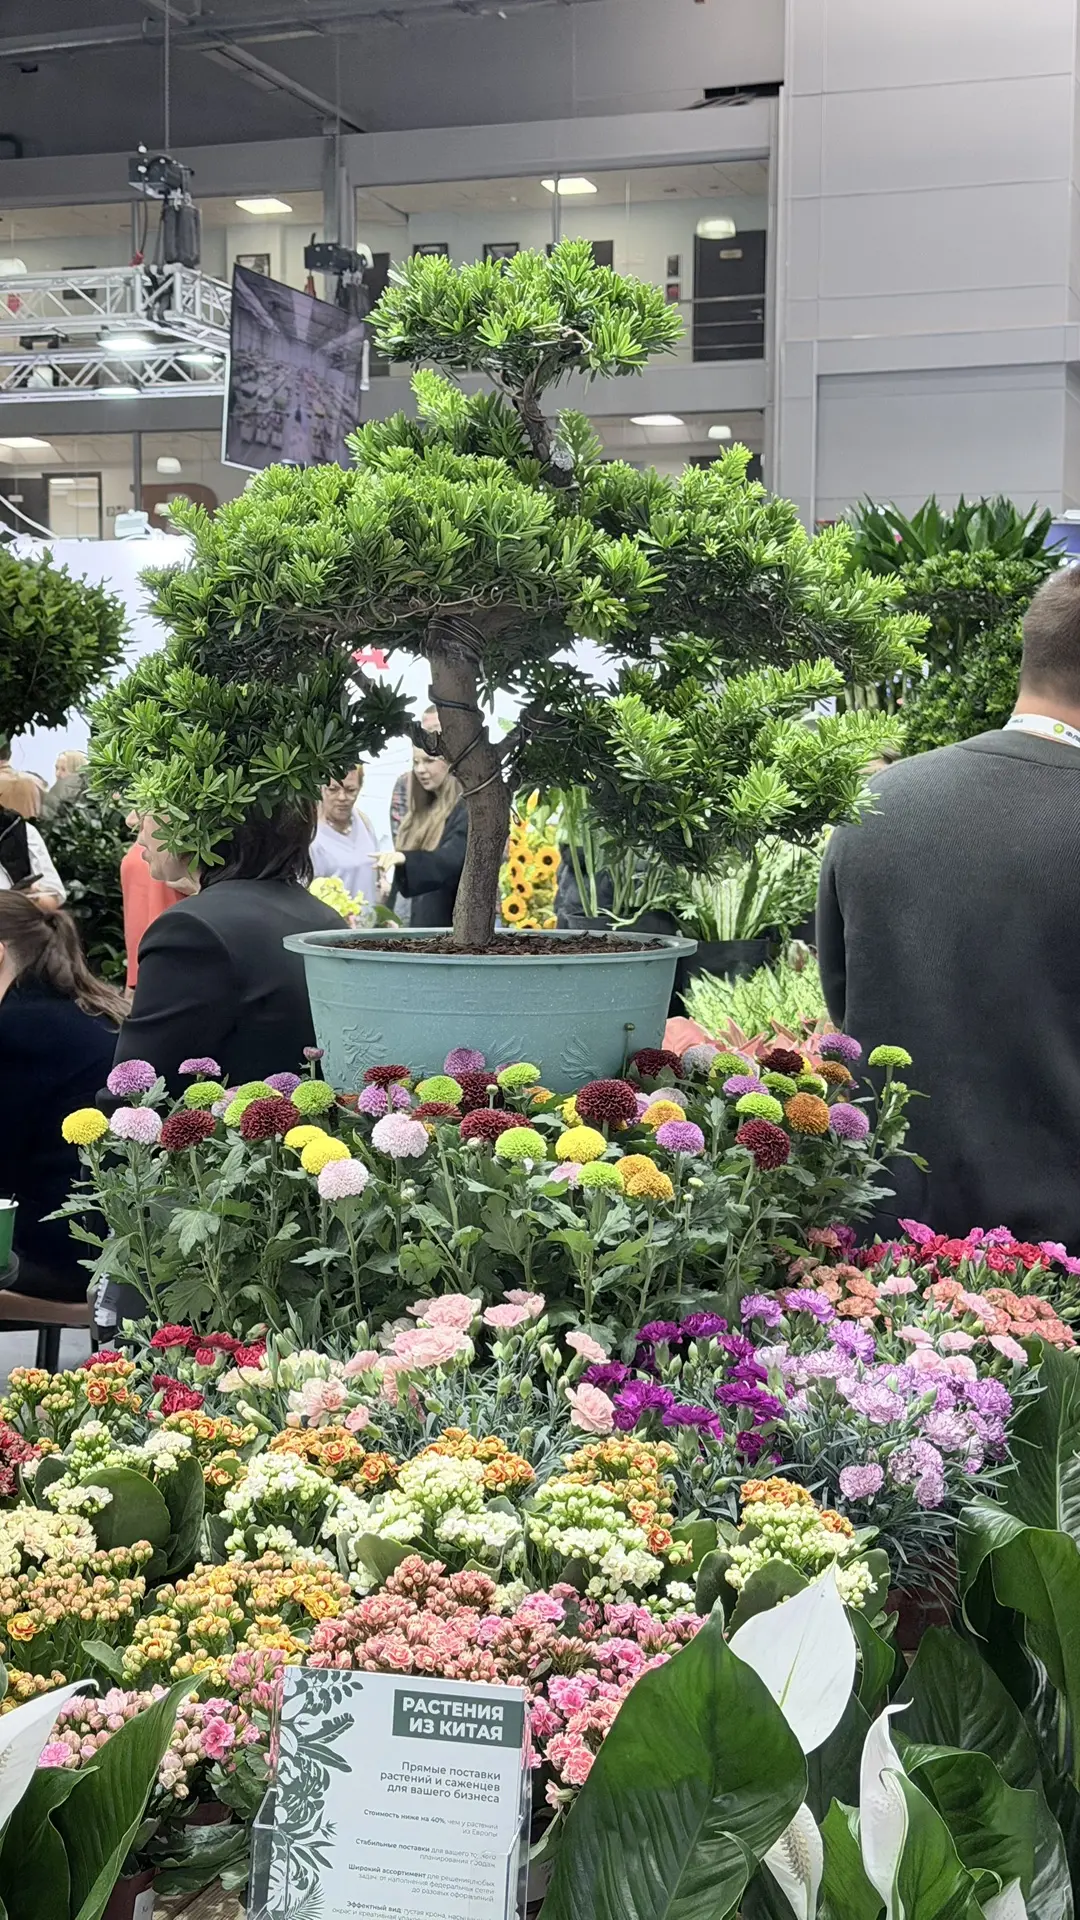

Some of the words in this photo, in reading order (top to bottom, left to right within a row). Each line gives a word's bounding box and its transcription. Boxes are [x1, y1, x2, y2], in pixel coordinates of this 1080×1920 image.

[402, 1697, 504, 1721] РАСТЕНИЯ
[409, 1717, 435, 1734] ИЗ
[439, 1720, 503, 1741] КИТАЯ
[402, 1761, 446, 1775] Прямые
[449, 1768, 501, 1780] поставки
[380, 1772, 432, 1785] растений
[445, 1779, 500, 1793] саженцев
[387, 1784, 407, 1794] для
[410, 1786, 451, 1798] вашего
[453, 1790, 500, 1803] бизнеса
[364, 1809, 399, 1819] Стоимость
[401, 1813, 419, 1821] ниже
[472, 1828, 498, 1838] Европы
[356, 1838, 397, 1848] Стабильные
[398, 1844, 430, 1852] поставки
[348, 1863, 381, 1873] Широкий
[382, 1867, 426, 1879] ассортимент
[347, 1900, 387, 1911] Эффектный
